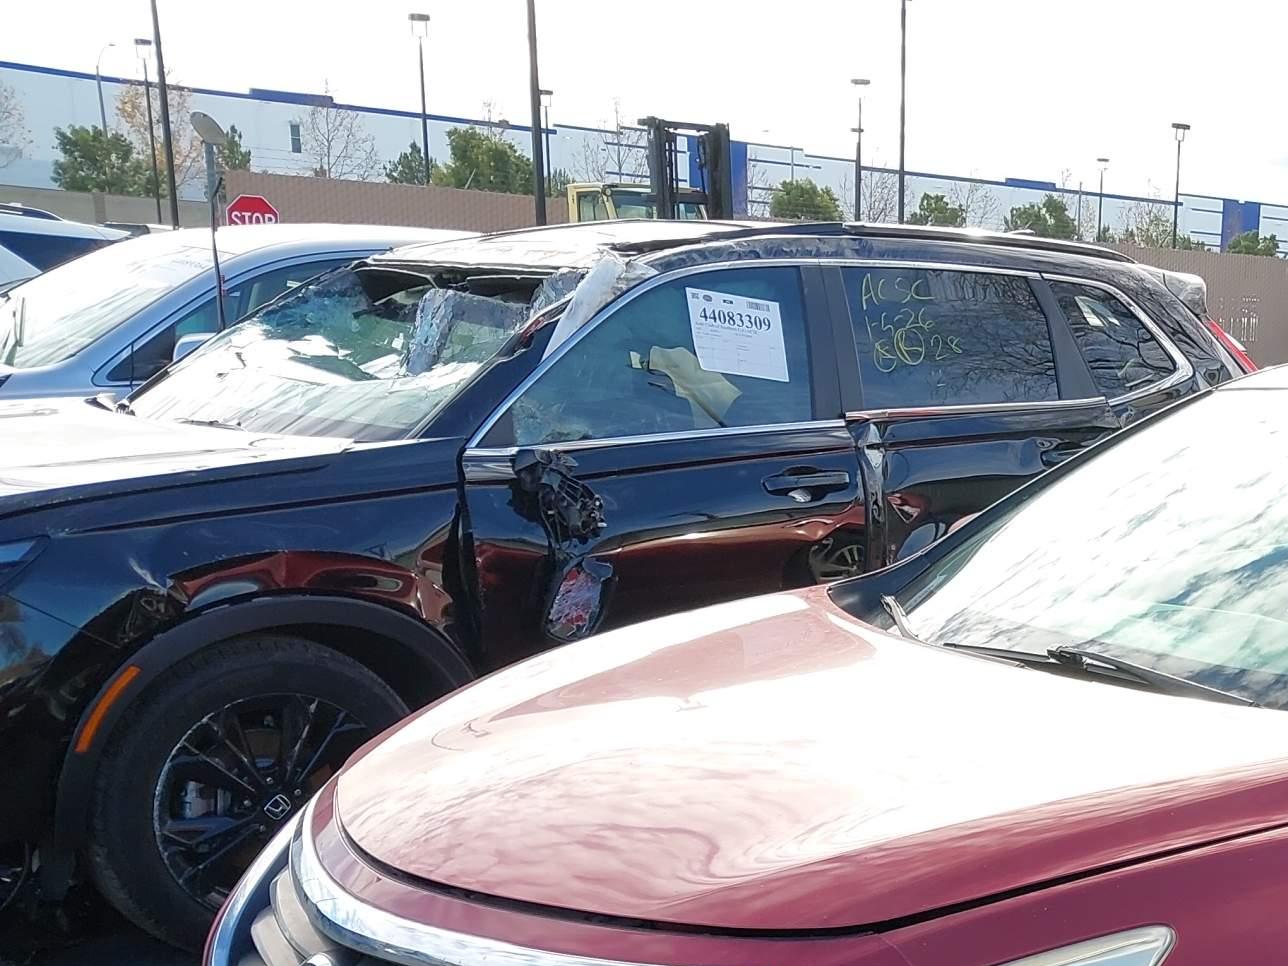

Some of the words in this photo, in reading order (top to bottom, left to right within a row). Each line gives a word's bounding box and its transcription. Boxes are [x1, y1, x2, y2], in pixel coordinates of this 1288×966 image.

[231, 211, 276, 225] STOP
[861, 273, 936, 310] ACSC
[699, 307, 771, 332] 44083309
